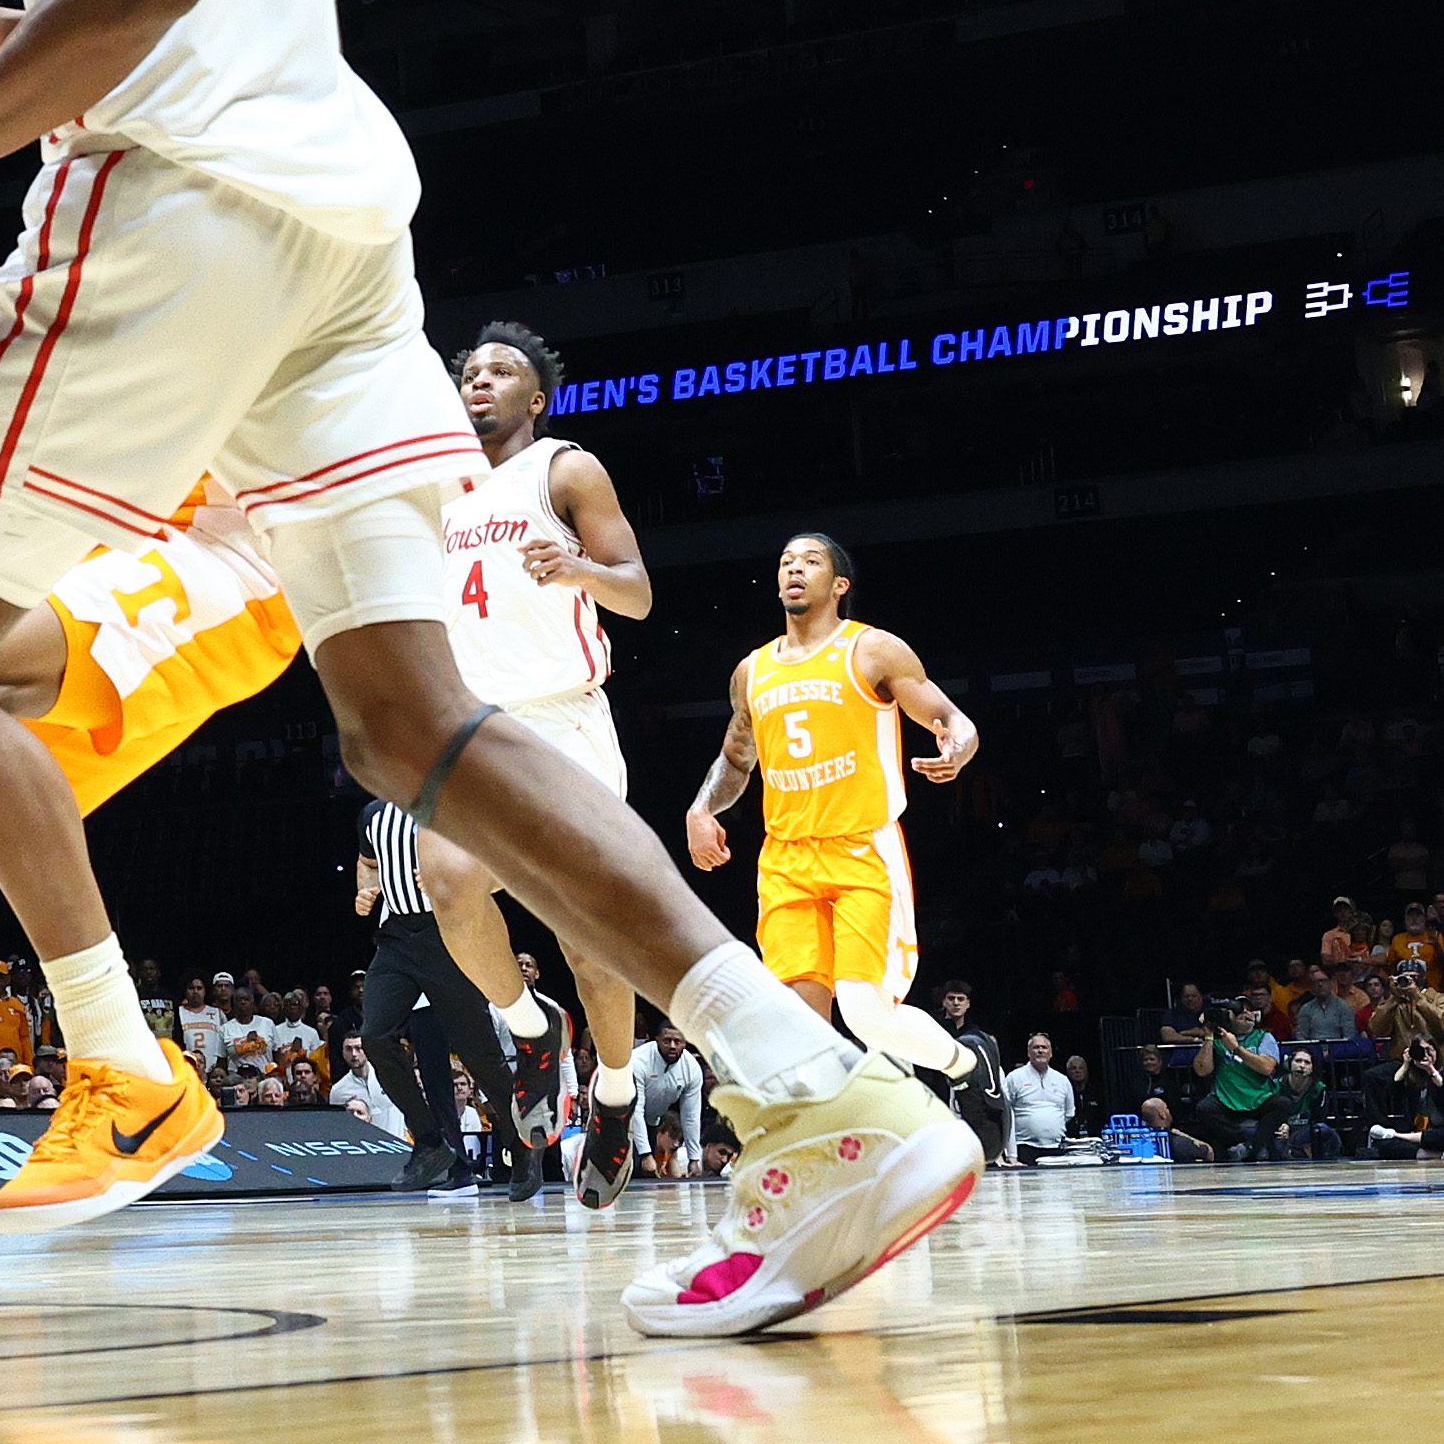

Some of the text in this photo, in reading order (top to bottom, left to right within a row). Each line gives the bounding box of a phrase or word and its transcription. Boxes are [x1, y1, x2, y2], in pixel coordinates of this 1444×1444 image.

[548, 290, 1274, 416] MEN'S BASKETBALL CHAMPIONSHIP
[461, 559, 489, 619] 4
[752, 678, 845, 722] TENNESSEE
[783, 709, 813, 759] 5
[264, 1139, 415, 1157] NISSAN
